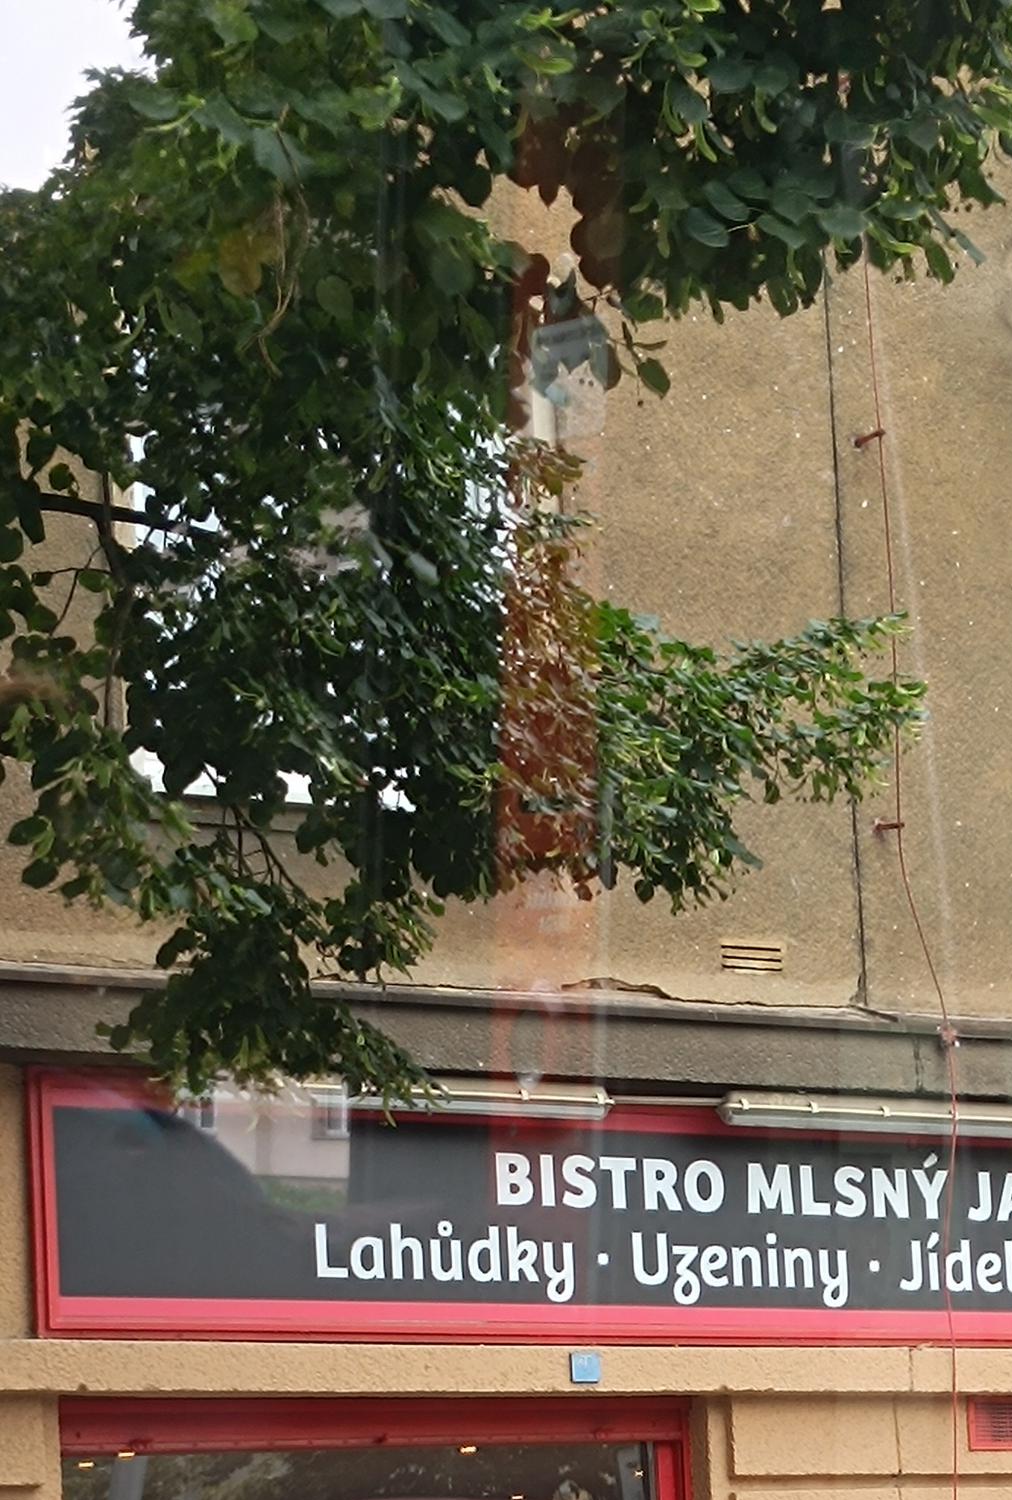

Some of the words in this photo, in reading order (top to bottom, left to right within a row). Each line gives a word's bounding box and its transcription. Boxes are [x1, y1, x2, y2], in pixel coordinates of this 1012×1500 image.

[494, 1151, 725, 1213] BISTRO
[747, 1153, 949, 1220] MLSNÝ
[314, 1220, 576, 1303] Lahůdky
[630, 1231, 850, 1308] Uzeniny
